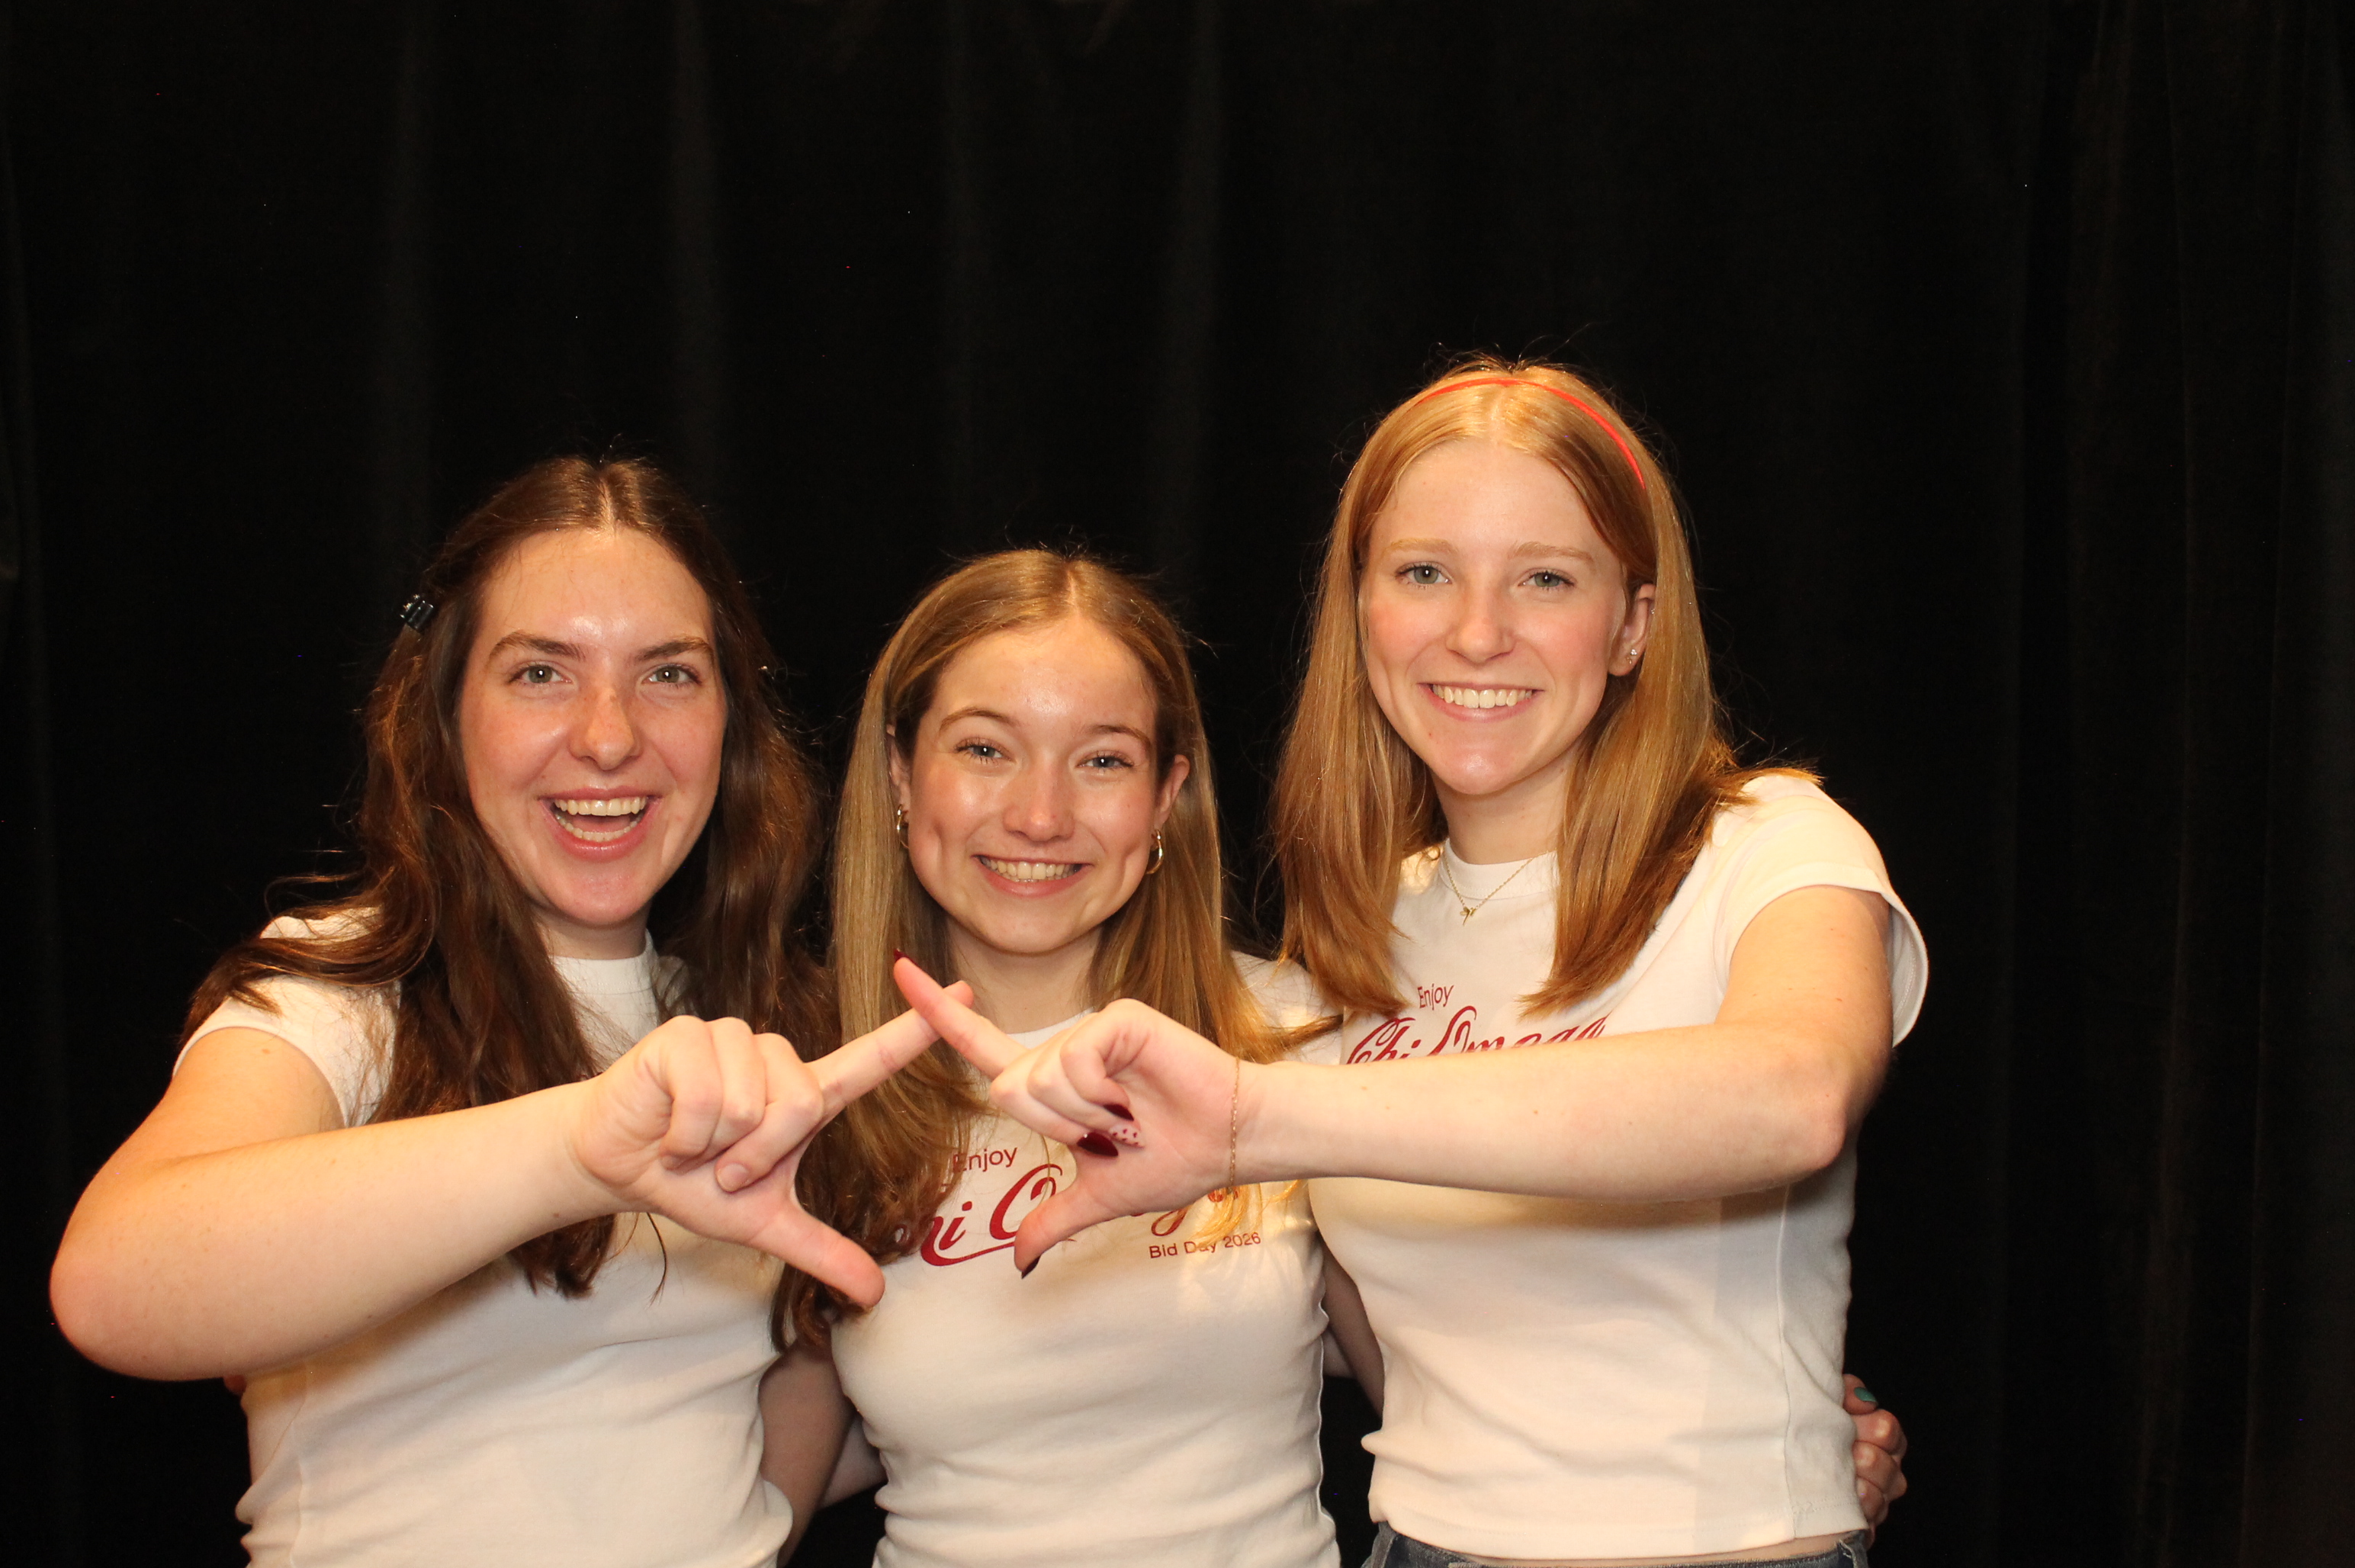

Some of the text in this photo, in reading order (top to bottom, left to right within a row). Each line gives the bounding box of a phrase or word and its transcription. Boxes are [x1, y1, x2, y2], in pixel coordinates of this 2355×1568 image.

[1417, 983, 1454, 1011] Enjoy
[1149, 1242, 1178, 1259] Bid
[1222, 1231, 1261, 1248] 2026
